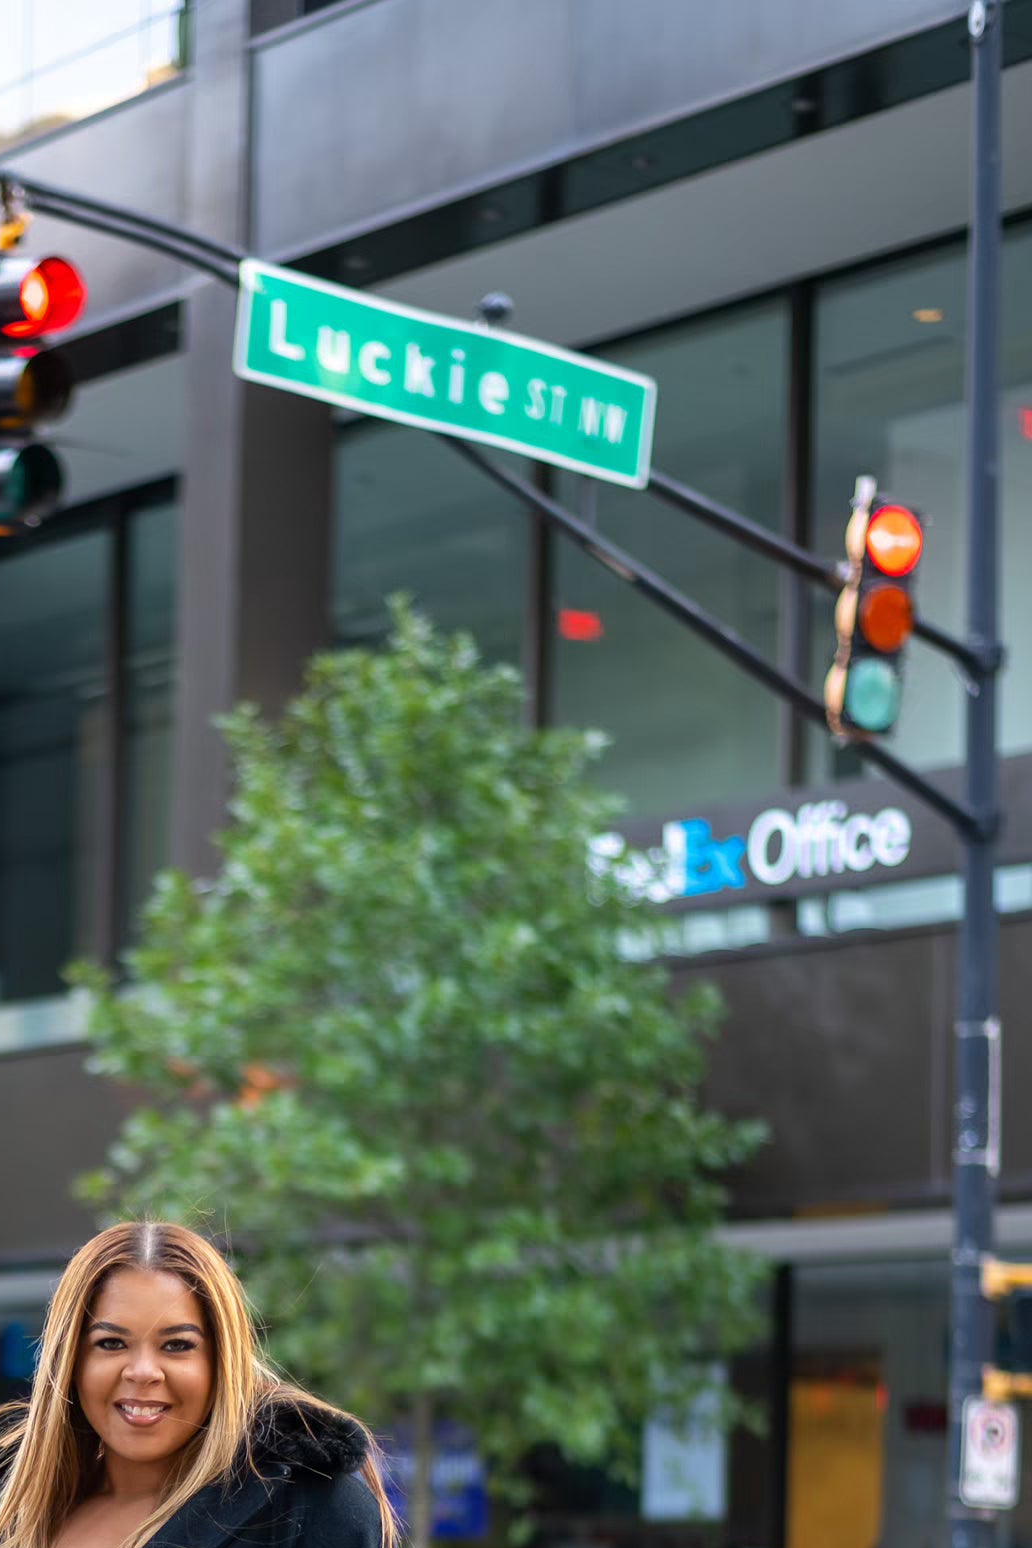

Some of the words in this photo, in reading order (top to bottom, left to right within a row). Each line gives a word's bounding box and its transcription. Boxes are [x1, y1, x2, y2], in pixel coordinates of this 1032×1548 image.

[268, 298, 510, 416] Luckie
[524, 378, 567, 425] ST
[577, 396, 628, 444] NW
[747, 800, 912, 885] Office
